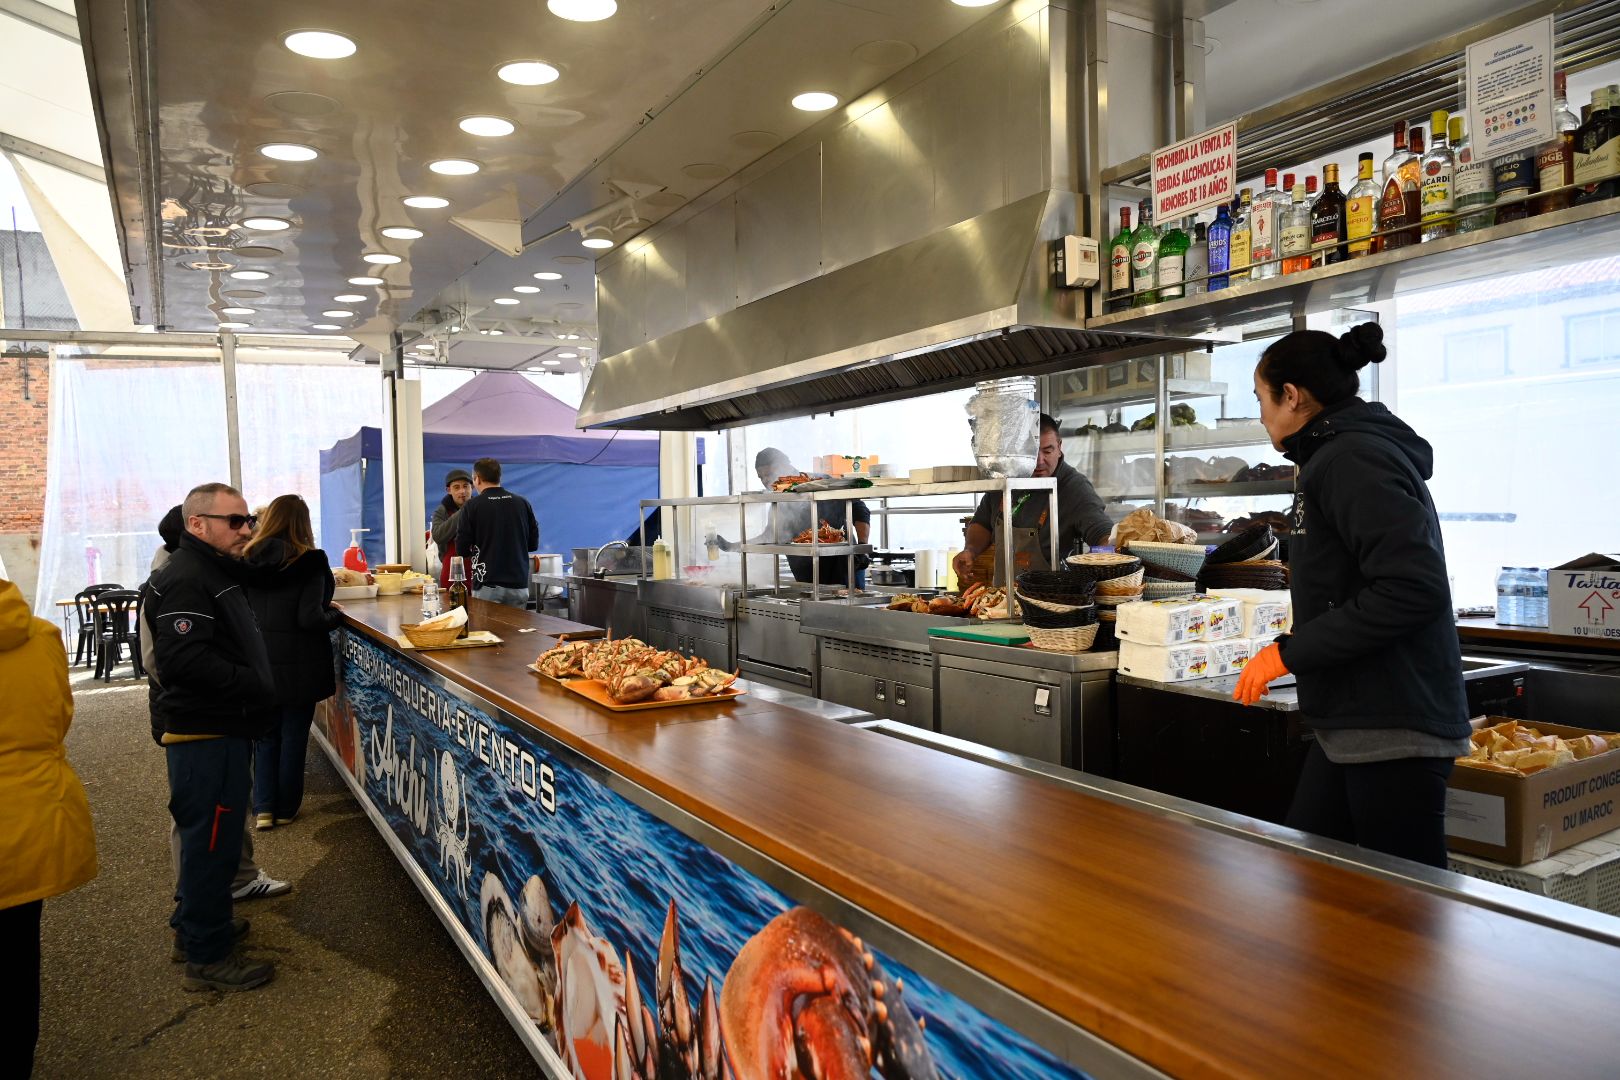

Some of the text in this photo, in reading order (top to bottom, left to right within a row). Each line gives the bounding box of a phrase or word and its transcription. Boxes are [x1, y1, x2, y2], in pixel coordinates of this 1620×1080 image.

[1156, 130, 1232, 172] PROHIBIDA LA VENTA DE
[1156, 153, 1232, 194] BEBIDAS ALCOHOLICAS A
[1160, 175, 1228, 213] MENORES DE 18 AÑOS
[1112, 256, 1130, 264] ARTINI
[1573, 626, 1581, 635] 10
[1543, 780, 1588, 809] PRODUIT
[1563, 800, 1613, 832] DU MAROC
